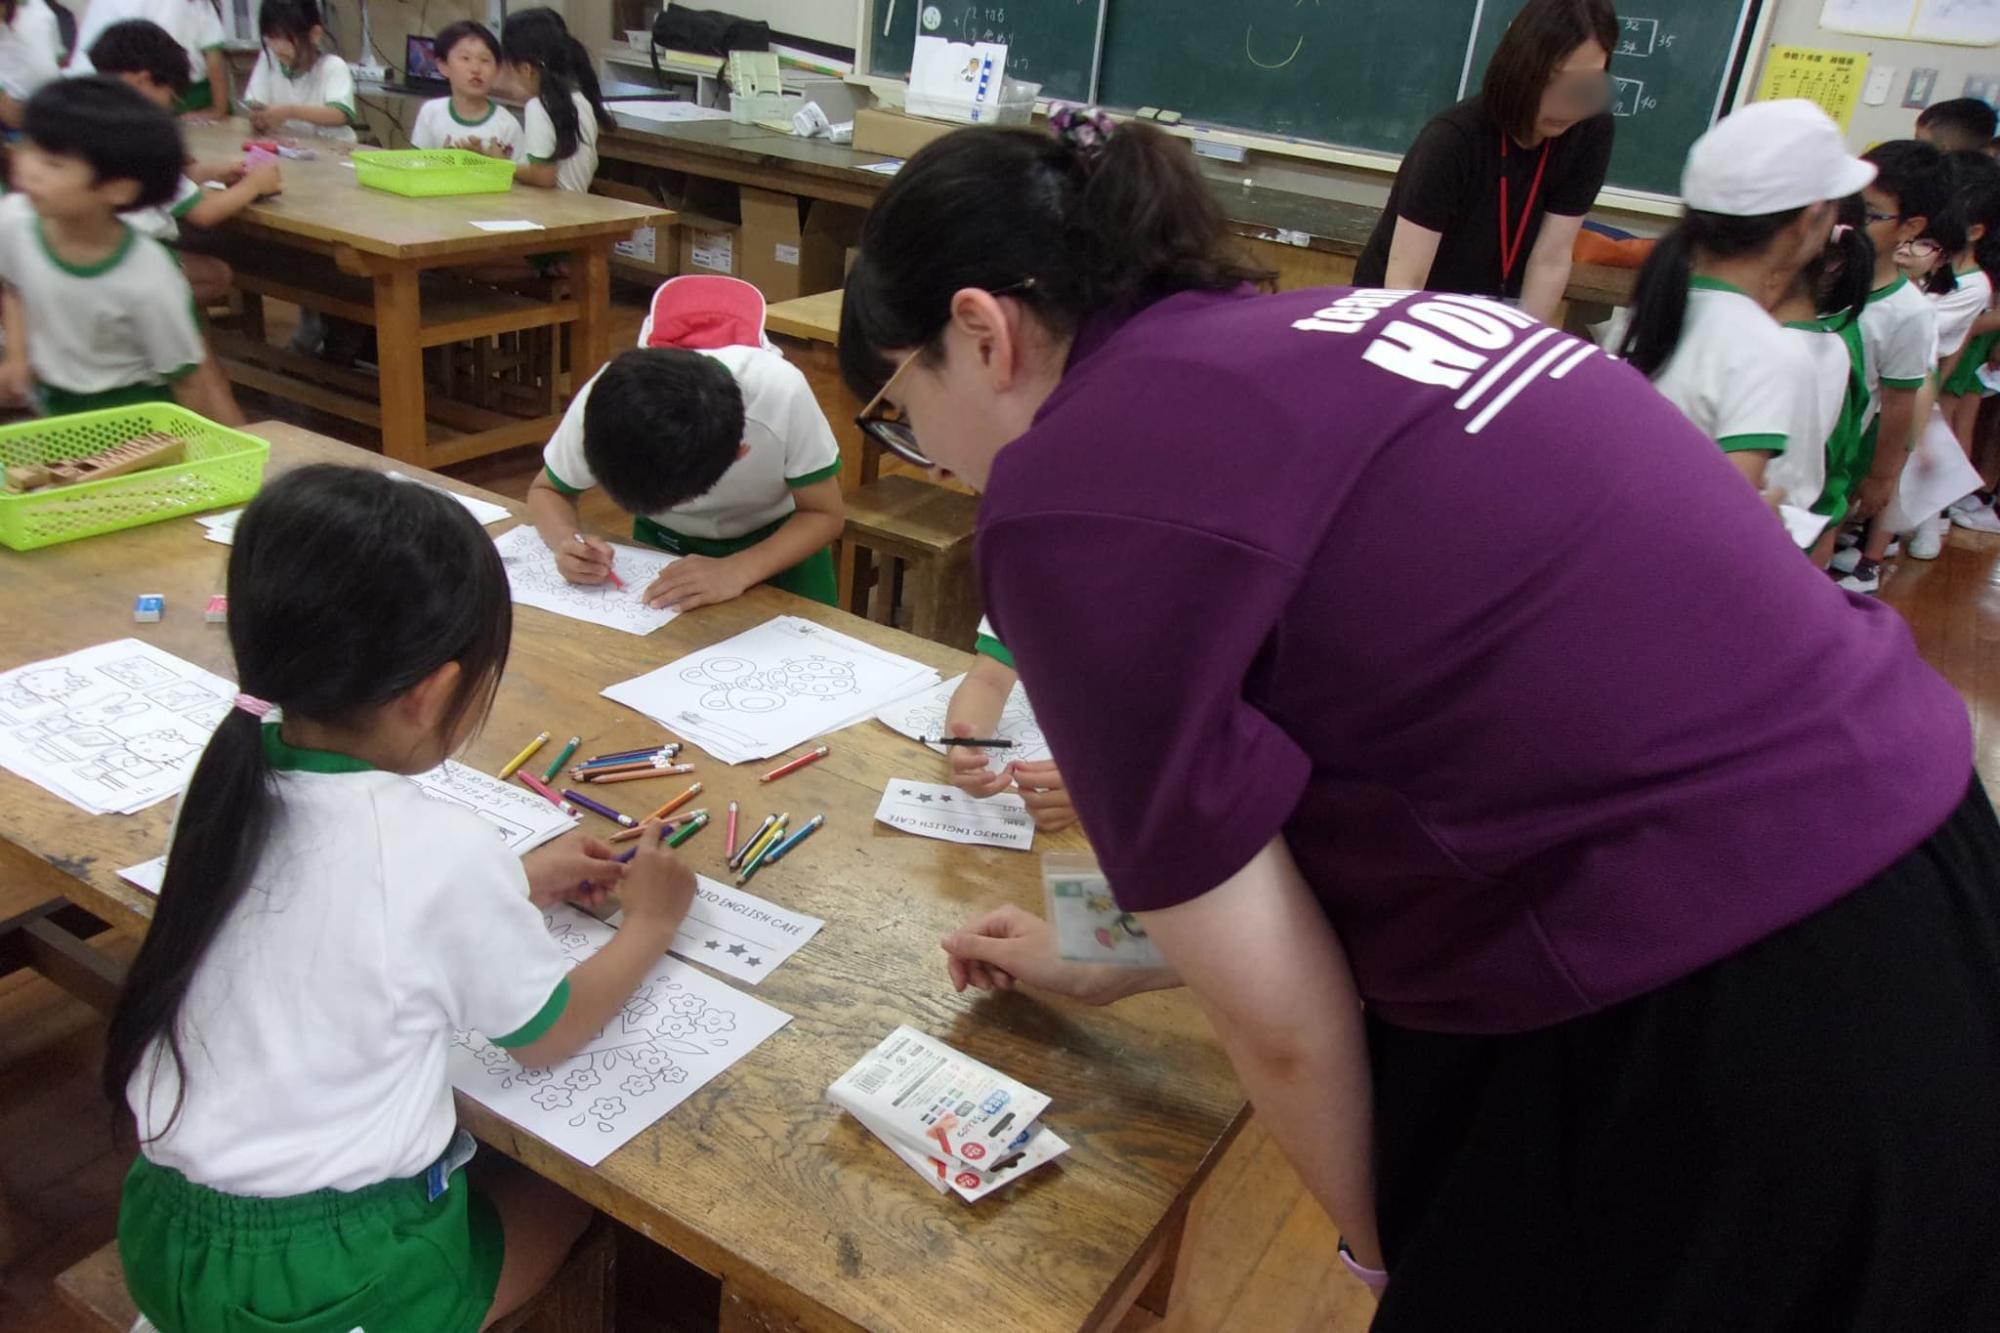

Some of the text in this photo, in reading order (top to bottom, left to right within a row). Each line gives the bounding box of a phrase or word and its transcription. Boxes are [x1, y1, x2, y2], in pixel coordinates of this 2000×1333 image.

[919, 821, 970, 836] ENGLISH
[973, 829, 1017, 841] HONJO
[695, 887, 720, 903] NJO
[718, 898, 770, 922] ENGLISH
